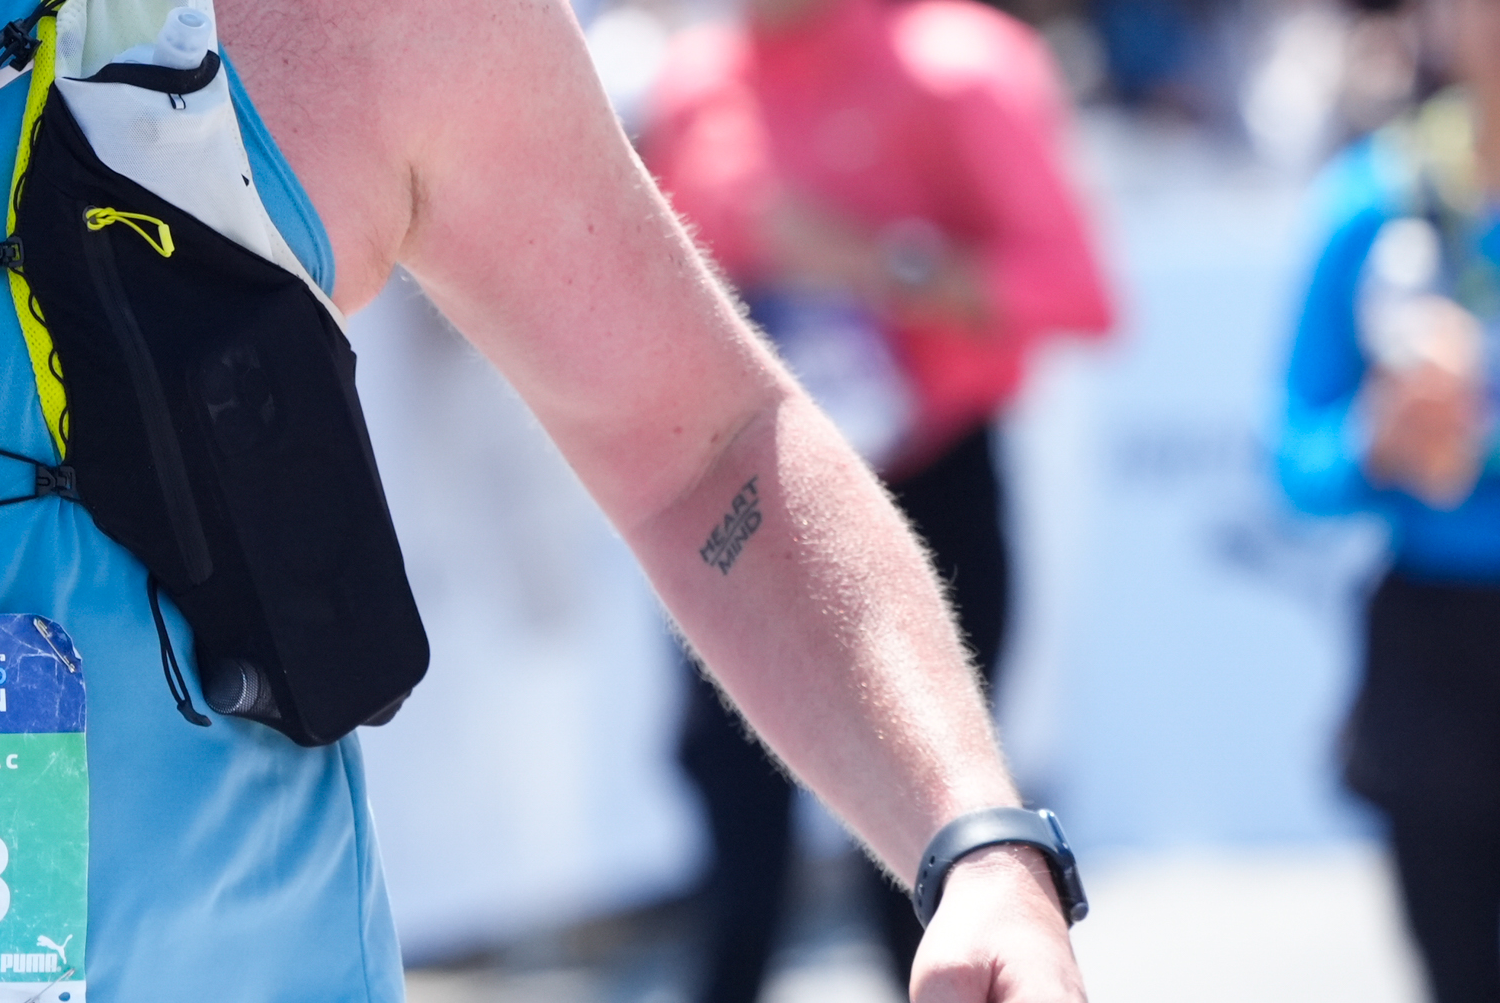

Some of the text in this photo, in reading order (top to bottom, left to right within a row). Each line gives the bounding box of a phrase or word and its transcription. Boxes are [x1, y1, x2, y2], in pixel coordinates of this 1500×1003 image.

[699, 474, 758, 564] HEART
[717, 511, 762, 576] MIND
[6, 754, 18, 770] C
[0, 953, 58, 973] PUMA
